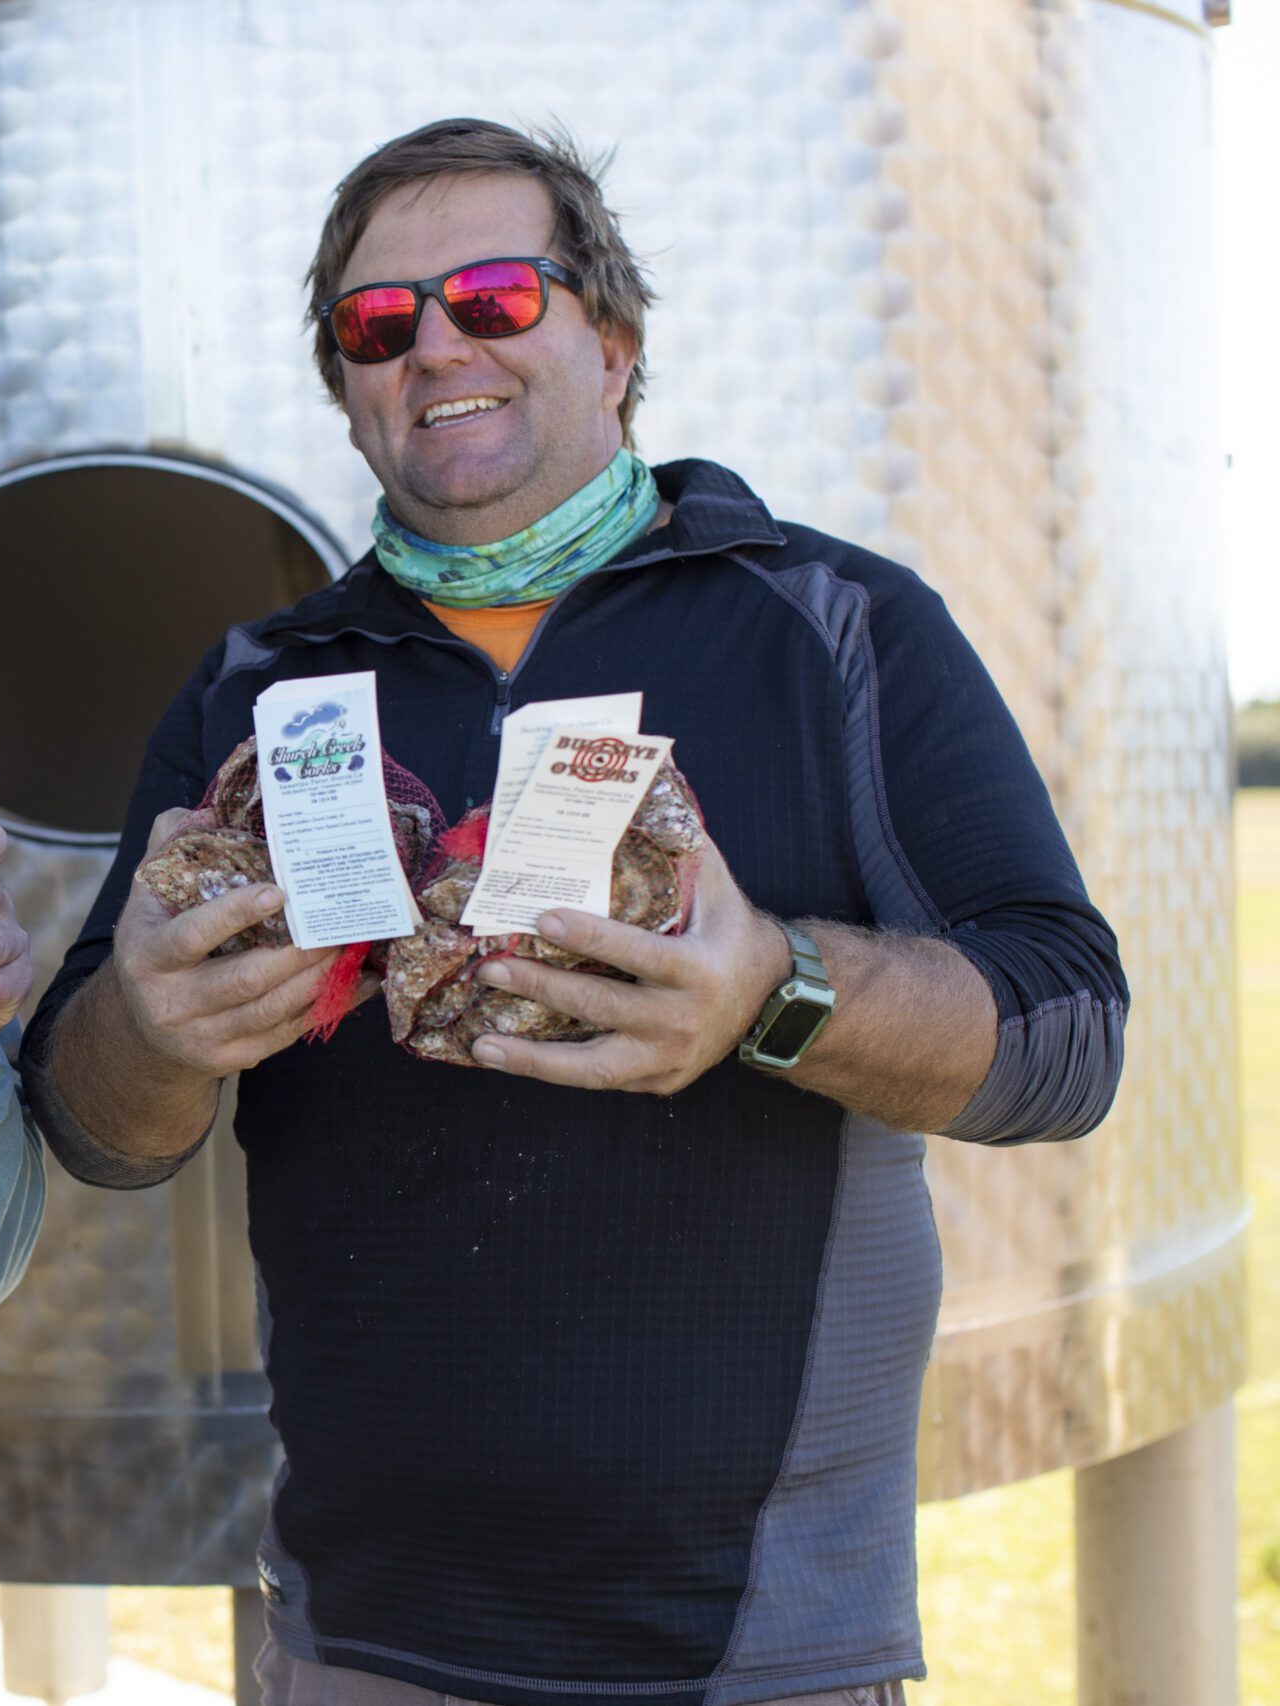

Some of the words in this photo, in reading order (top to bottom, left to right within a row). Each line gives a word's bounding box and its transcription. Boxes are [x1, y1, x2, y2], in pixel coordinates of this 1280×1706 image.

[268, 741, 320, 766] Church
[322, 733, 366, 757] Creek
[555, 736, 659, 760] BULLSEYE
[550, 761, 639, 783] OYSTERS
